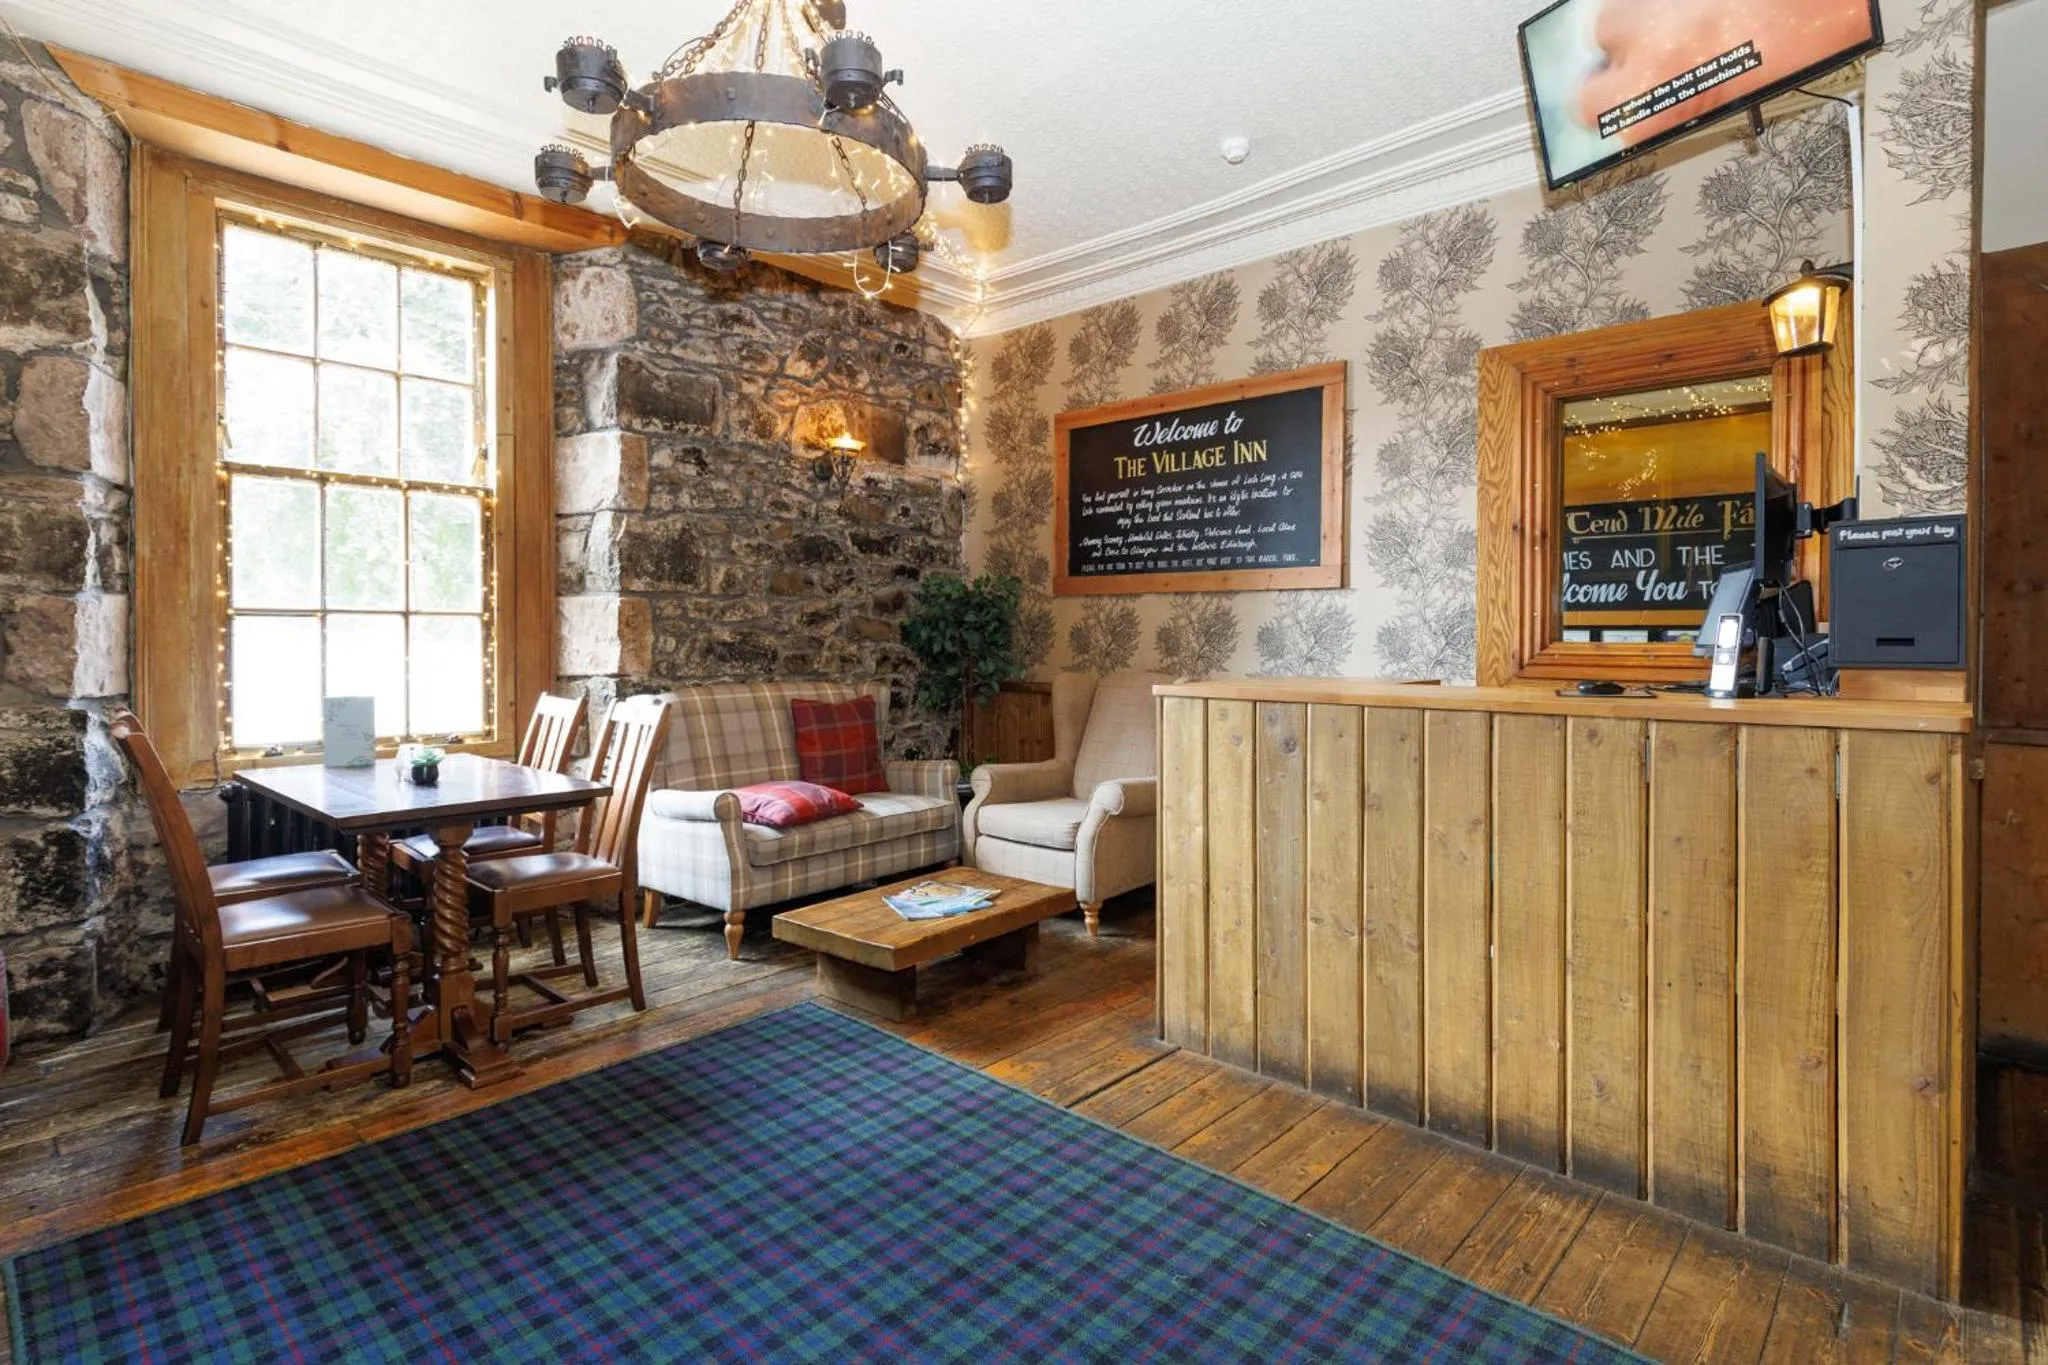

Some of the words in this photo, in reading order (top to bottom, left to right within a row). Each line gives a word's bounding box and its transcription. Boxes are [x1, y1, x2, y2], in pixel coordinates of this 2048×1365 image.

[1600, 109, 1621, 124] spot
[1622, 93, 1652, 113] where
[1653, 85, 1671, 98] the
[1672, 73, 1695, 89] bolt
[1695, 61, 1718, 78] that
[1720, 45, 1752, 66] holds
[1602, 123, 1618, 136] the
[1620, 108, 1652, 128] handle
[1653, 96, 1676, 112] onto
[1677, 86, 1696, 100] the
[1697, 64, 1742, 91] machine
[1744, 58, 1759, 69] is.
[1133, 416, 1219, 447] Welcome
[1224, 411, 1245, 435] to
[1114, 456, 1147, 480] THE
[1152, 446, 1226, 474] VILLAGE
[1234, 439, 1268, 465] INN
[1839, 529, 1879, 541] Please
[1881, 528, 1903, 540] post
[1905, 526, 1931, 539] your
[1934, 524, 1955, 538] key
[1611, 548, 1655, 569] AND
[1677, 545, 1725, 566] THE
[1636, 569, 1688, 601] You
